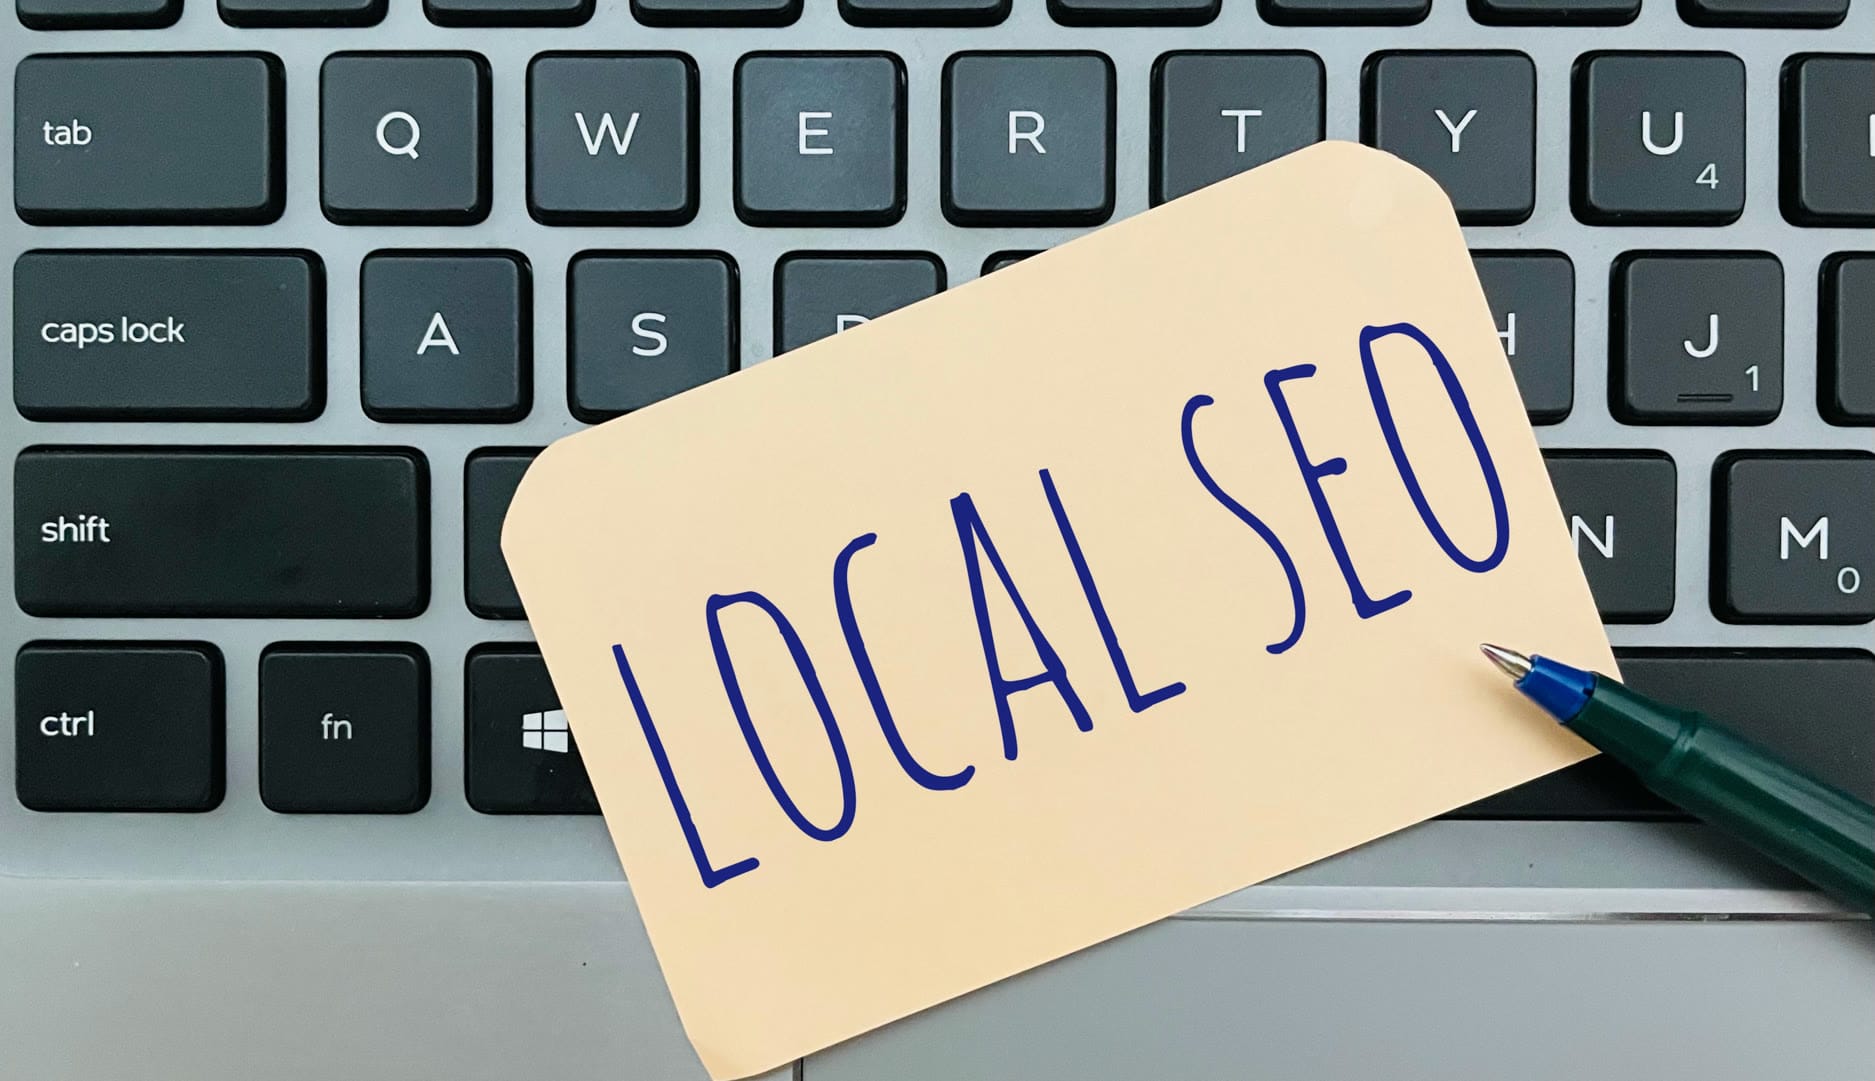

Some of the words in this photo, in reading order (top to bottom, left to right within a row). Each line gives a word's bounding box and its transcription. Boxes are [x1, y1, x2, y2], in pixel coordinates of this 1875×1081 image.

[43, 119, 91, 145] tab
[376, 112, 419, 159] Q
[575, 113, 639, 155] W
[799, 112, 833, 154] E
[1009, 111, 1046, 153] R
[1222, 110, 1262, 152] T
[1435, 110, 1477, 152] Y
[1643, 112, 1683, 155] U
[1696, 164, 1719, 189] 4
[41, 323, 114, 348] caps
[122, 317, 184, 342] lock
[417, 313, 459, 354] A
[632, 313, 667, 356] S
[1684, 314, 1718, 357] J
[1746, 366, 1758, 391] 1
[42, 515, 110, 542] shift
[1572, 515, 1614, 558] N
[1781, 517, 1828, 559] M
[613, 470, 1186, 889] LOCAL
[1182, 323, 1510, 654] SEO
[41, 711, 93, 736] ctrl
[322, 713, 351, 739] fn
